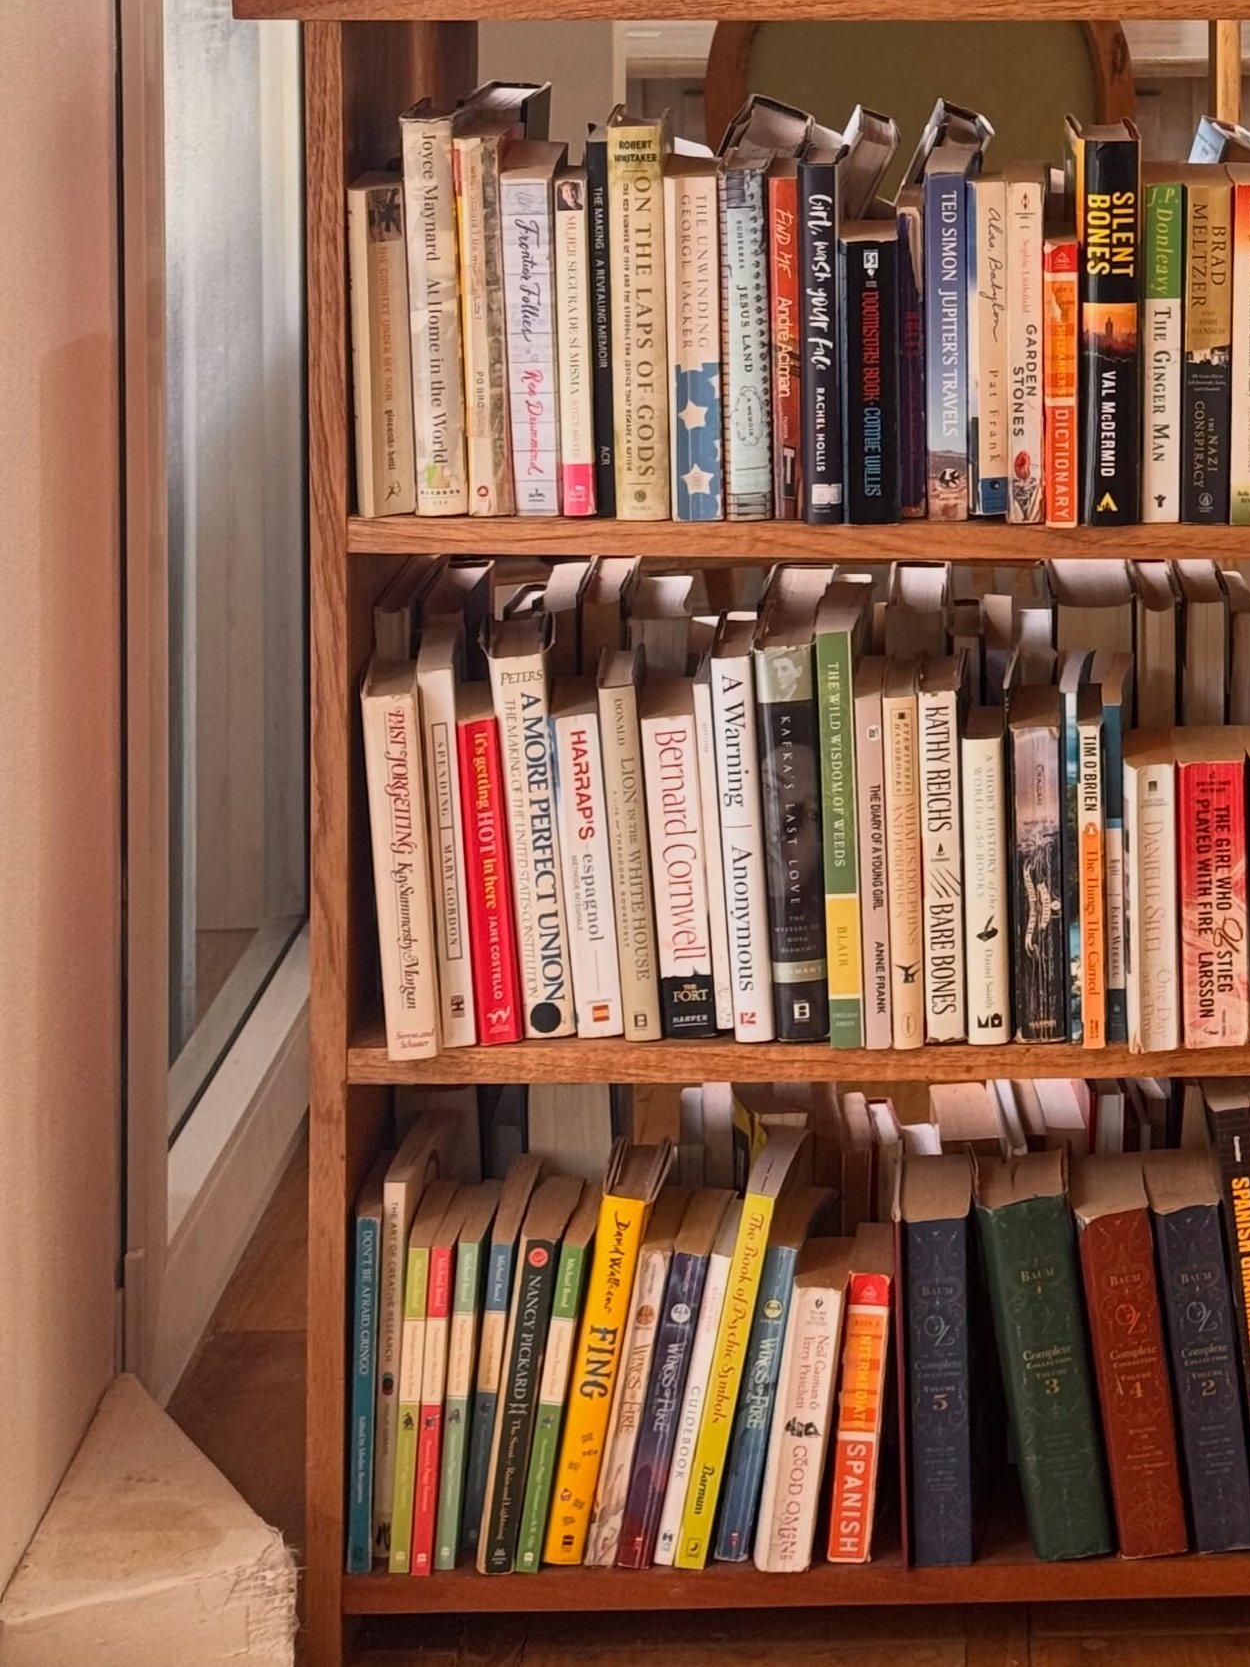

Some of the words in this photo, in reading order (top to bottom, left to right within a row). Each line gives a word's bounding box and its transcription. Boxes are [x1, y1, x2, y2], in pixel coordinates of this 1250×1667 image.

[422, 133, 436, 179] Joyce
[614, 153, 658, 163] WHITAKER
[618, 140, 652, 150] ROBERT
[634, 176, 651, 213] ON
[942, 191, 957, 224] TED
[424, 184, 441, 261] Maynard
[635, 221, 651, 275] THE
[1087, 194, 1110, 276] BONES
[1113, 191, 1133, 277] SILENT
[942, 227, 957, 281] SIMON
[426, 278, 441, 297] At
[427, 301, 441, 347] Home
[635, 285, 653, 348] LAPS
[938, 290, 958, 371] JUPITER'S
[1154, 307, 1170, 342] THE
[429, 352, 441, 366] in
[636, 355, 654, 392] OF
[1101, 371, 1115, 397] VAL
[1153, 349, 1170, 414] GINGER
[429, 370, 442, 406] the
[942, 373, 958, 436] TRAVELS
[431, 409, 448, 463] World
[637, 401, 655, 476] GODS
[1101, 401, 1115, 477] McDERMID
[1153, 421, 1168, 462] MAN
[1054, 410, 1070, 520] DICTIONARY
[521, 693, 541, 711] A
[722, 675, 741, 693] A
[523, 717, 549, 793] MORE
[723, 700, 751, 808] Warning
[925, 706, 949, 767] KATHY
[1082, 735, 1097, 757] TIM
[570, 730, 595, 841] HARRAP'S
[654, 727, 698, 836] Bernard
[927, 770, 952, 832] REICHS
[1084, 760, 1098, 811] O'BRIEN
[1196, 798, 1210, 857] PLAYED
[1215, 805, 1230, 832] THE
[530, 799, 556, 905] PERFECT
[1198, 861, 1212, 896] WITH
[1215, 836, 1231, 870] GIRL
[581, 853, 604, 942] espagnol
[663, 844, 707, 963] Cornwell
[731, 845, 756, 992] Anonymous
[1198, 901, 1213, 935] FIRE
[1217, 873, 1232, 910] WHO
[930, 903, 954, 953] BARE
[538, 913, 566, 1004] UNION
[932, 957, 956, 1015] BONES
[1198, 951, 1215, 1018] LARSSON
[1217, 951, 1233, 992] STIEG
[876, 977, 886, 1013] FRANK
[522, 1275, 541, 1331] NANCY
[515, 1333, 536, 1399] PICKARD
[579, 1326, 619, 1399] FING
[839, 1444, 867, 1553] SPANISH
